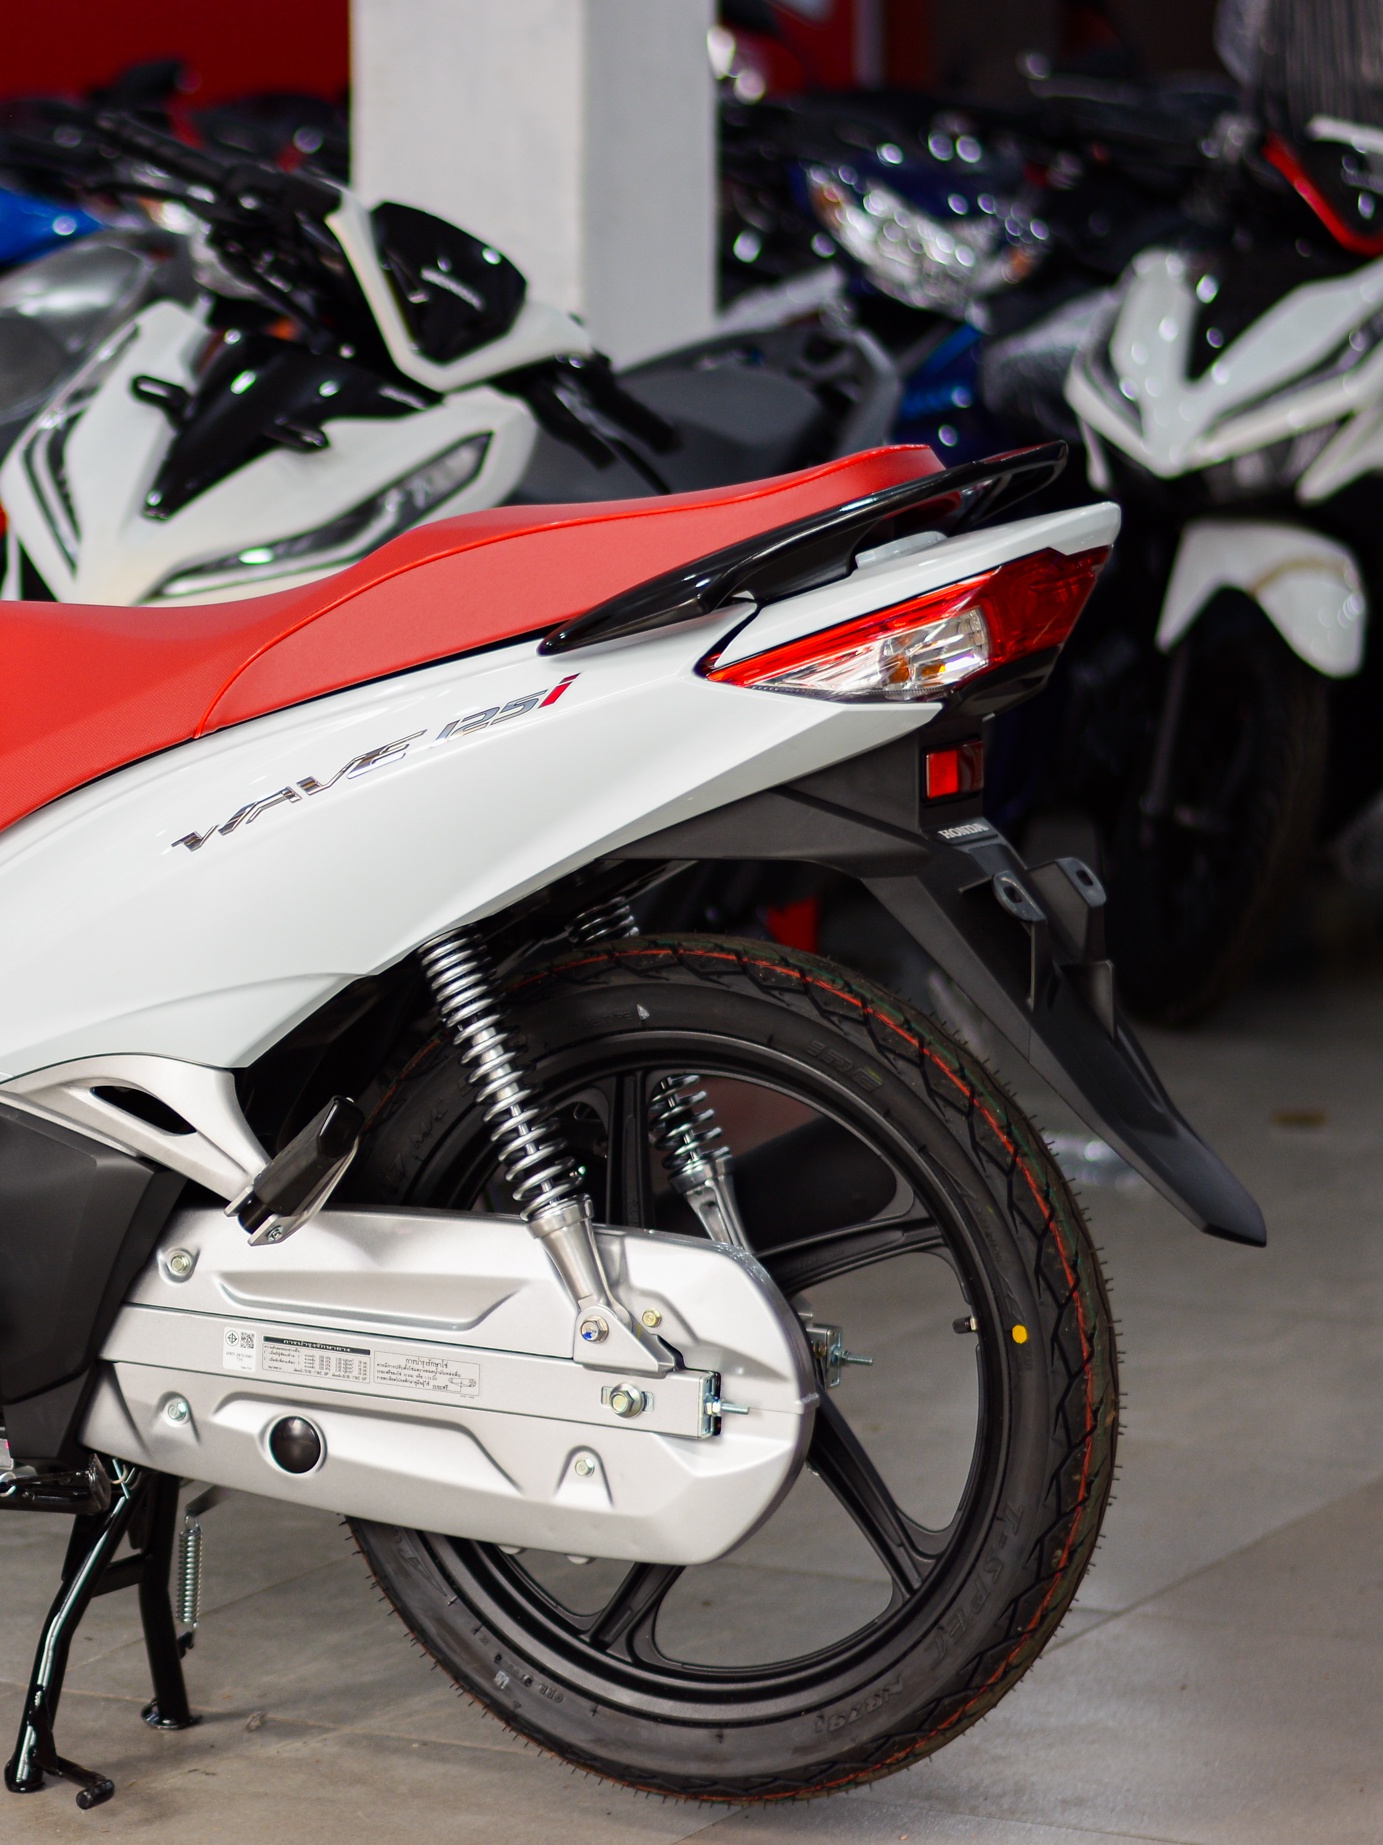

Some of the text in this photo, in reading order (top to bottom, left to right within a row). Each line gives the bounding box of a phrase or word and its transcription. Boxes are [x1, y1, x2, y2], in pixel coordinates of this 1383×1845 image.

[171, 672, 581, 852] WAVE 125i
[937, 822, 989, 839] HONDA
